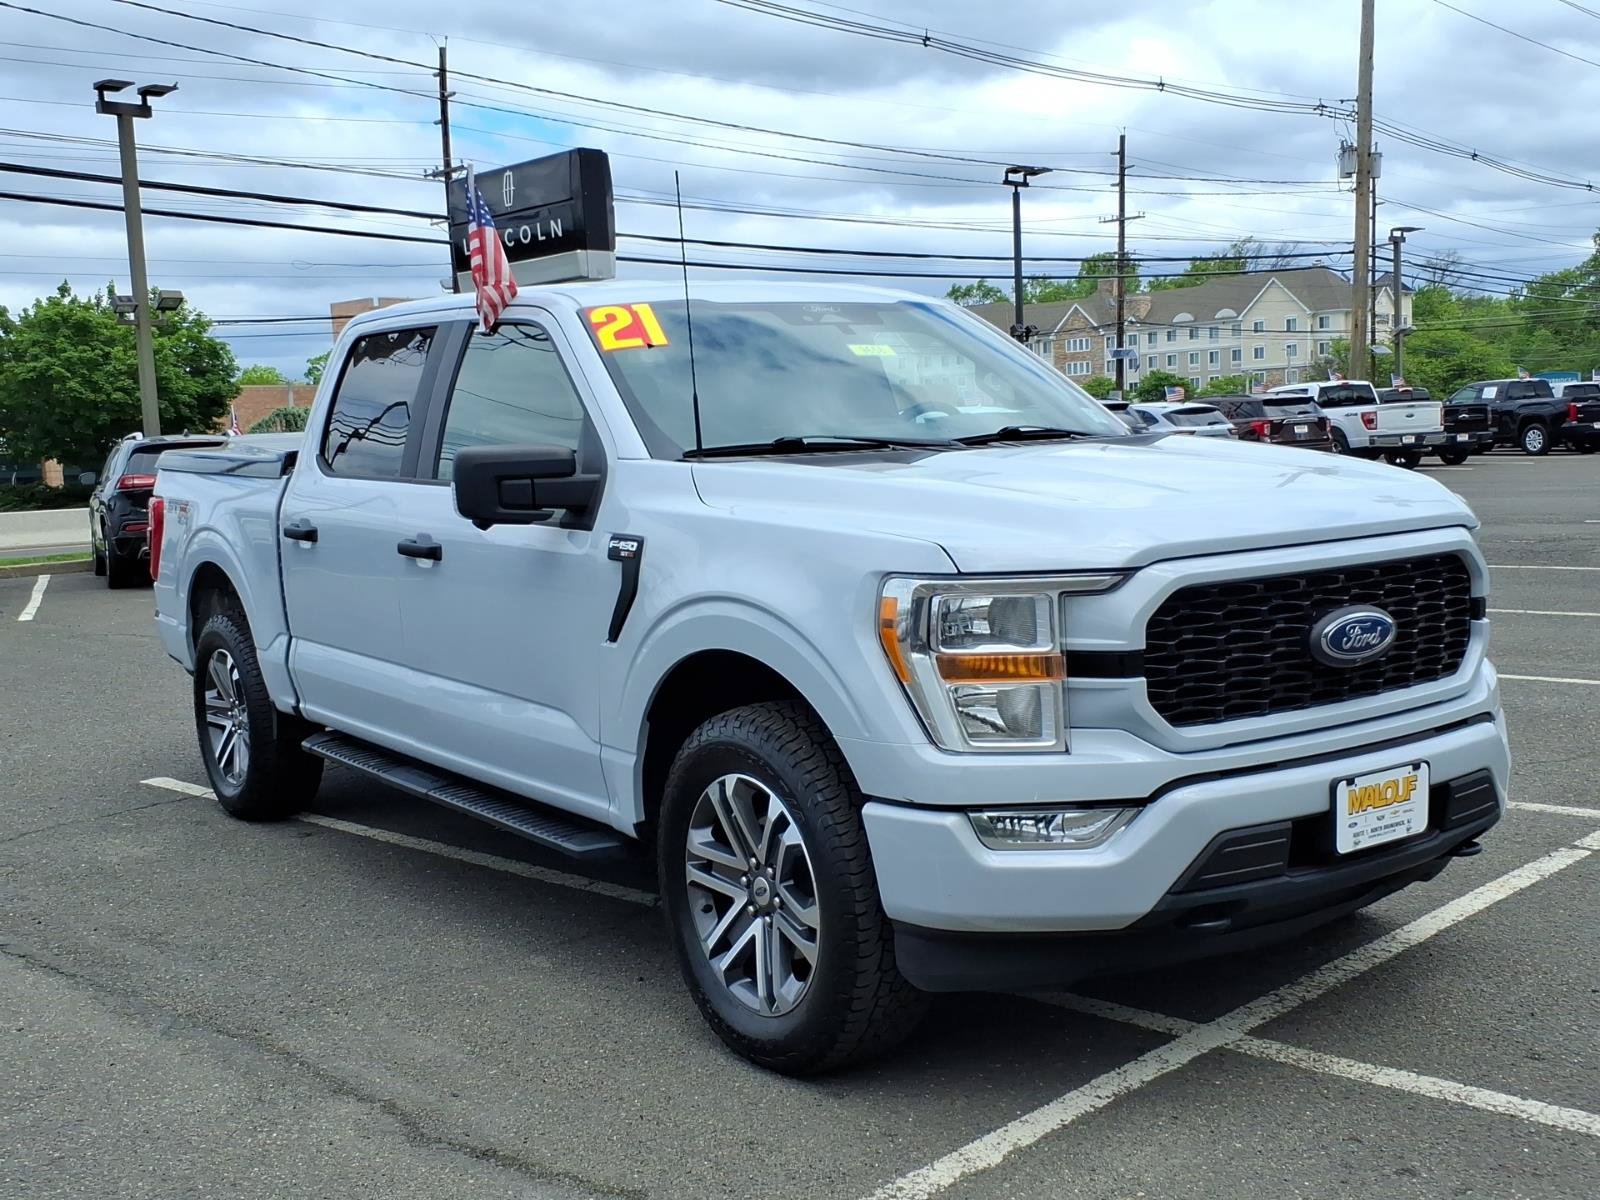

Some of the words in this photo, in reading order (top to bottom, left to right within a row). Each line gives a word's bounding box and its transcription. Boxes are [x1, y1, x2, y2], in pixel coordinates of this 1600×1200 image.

[463, 218, 563, 256] LCOLN
[590, 303, 669, 351] 21
[609, 540, 638, 551] F-150
[1343, 623, 1381, 649] Ford
[1348, 775, 1417, 815] MALOUF
